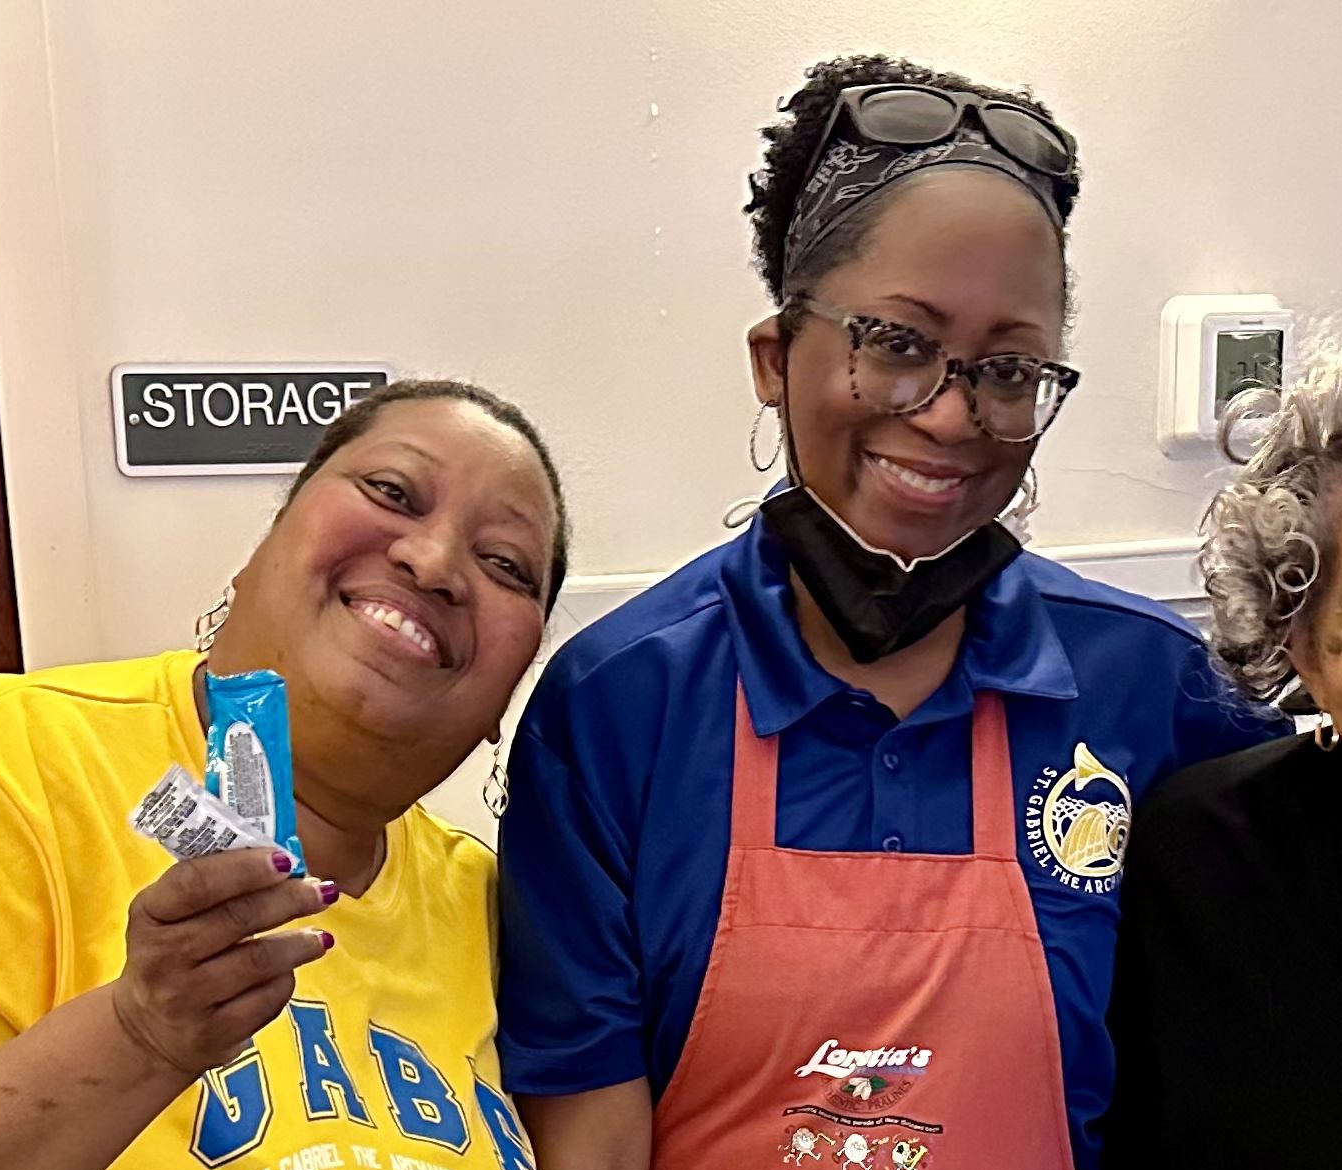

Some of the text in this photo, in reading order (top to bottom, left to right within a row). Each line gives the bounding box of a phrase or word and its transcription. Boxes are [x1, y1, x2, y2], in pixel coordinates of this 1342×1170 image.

[1032, 766, 1058, 790] ST.
[1025, 795, 1052, 867] GABRIEL
[1050, 864, 1081, 890] THE
[793, 1039, 933, 1079] Loretta's
[349, 1144, 383, 1170] THE
